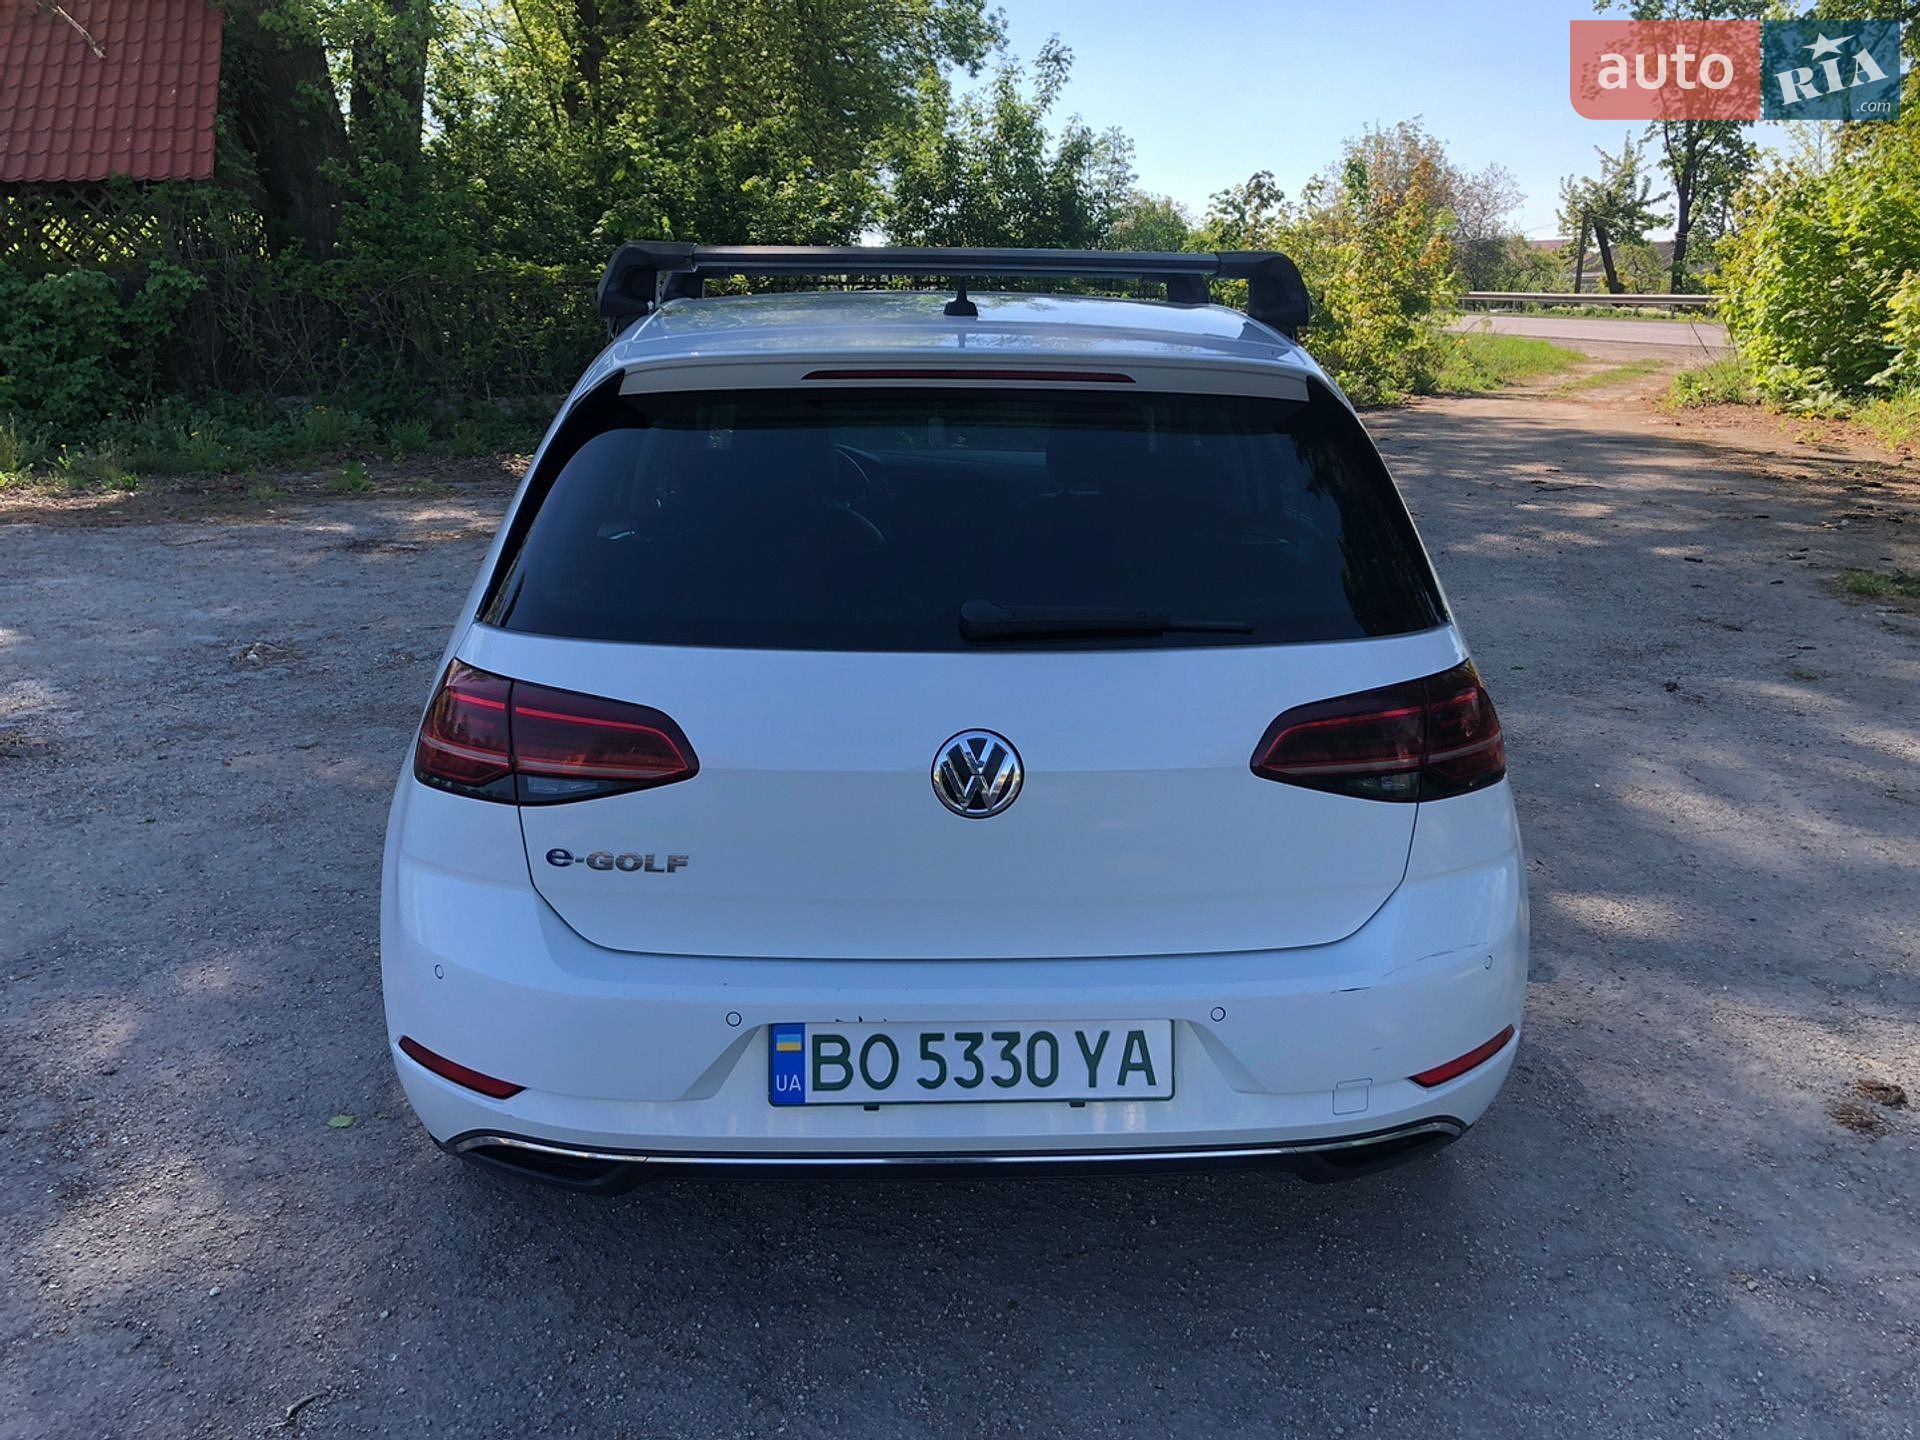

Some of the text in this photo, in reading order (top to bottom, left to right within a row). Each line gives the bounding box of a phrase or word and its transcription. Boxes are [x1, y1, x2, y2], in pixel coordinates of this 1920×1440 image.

[545, 848, 690, 873] e-GOLF
[812, 1029, 1157, 1091] BO 5330 YA
[776, 1073, 801, 1092] UA
